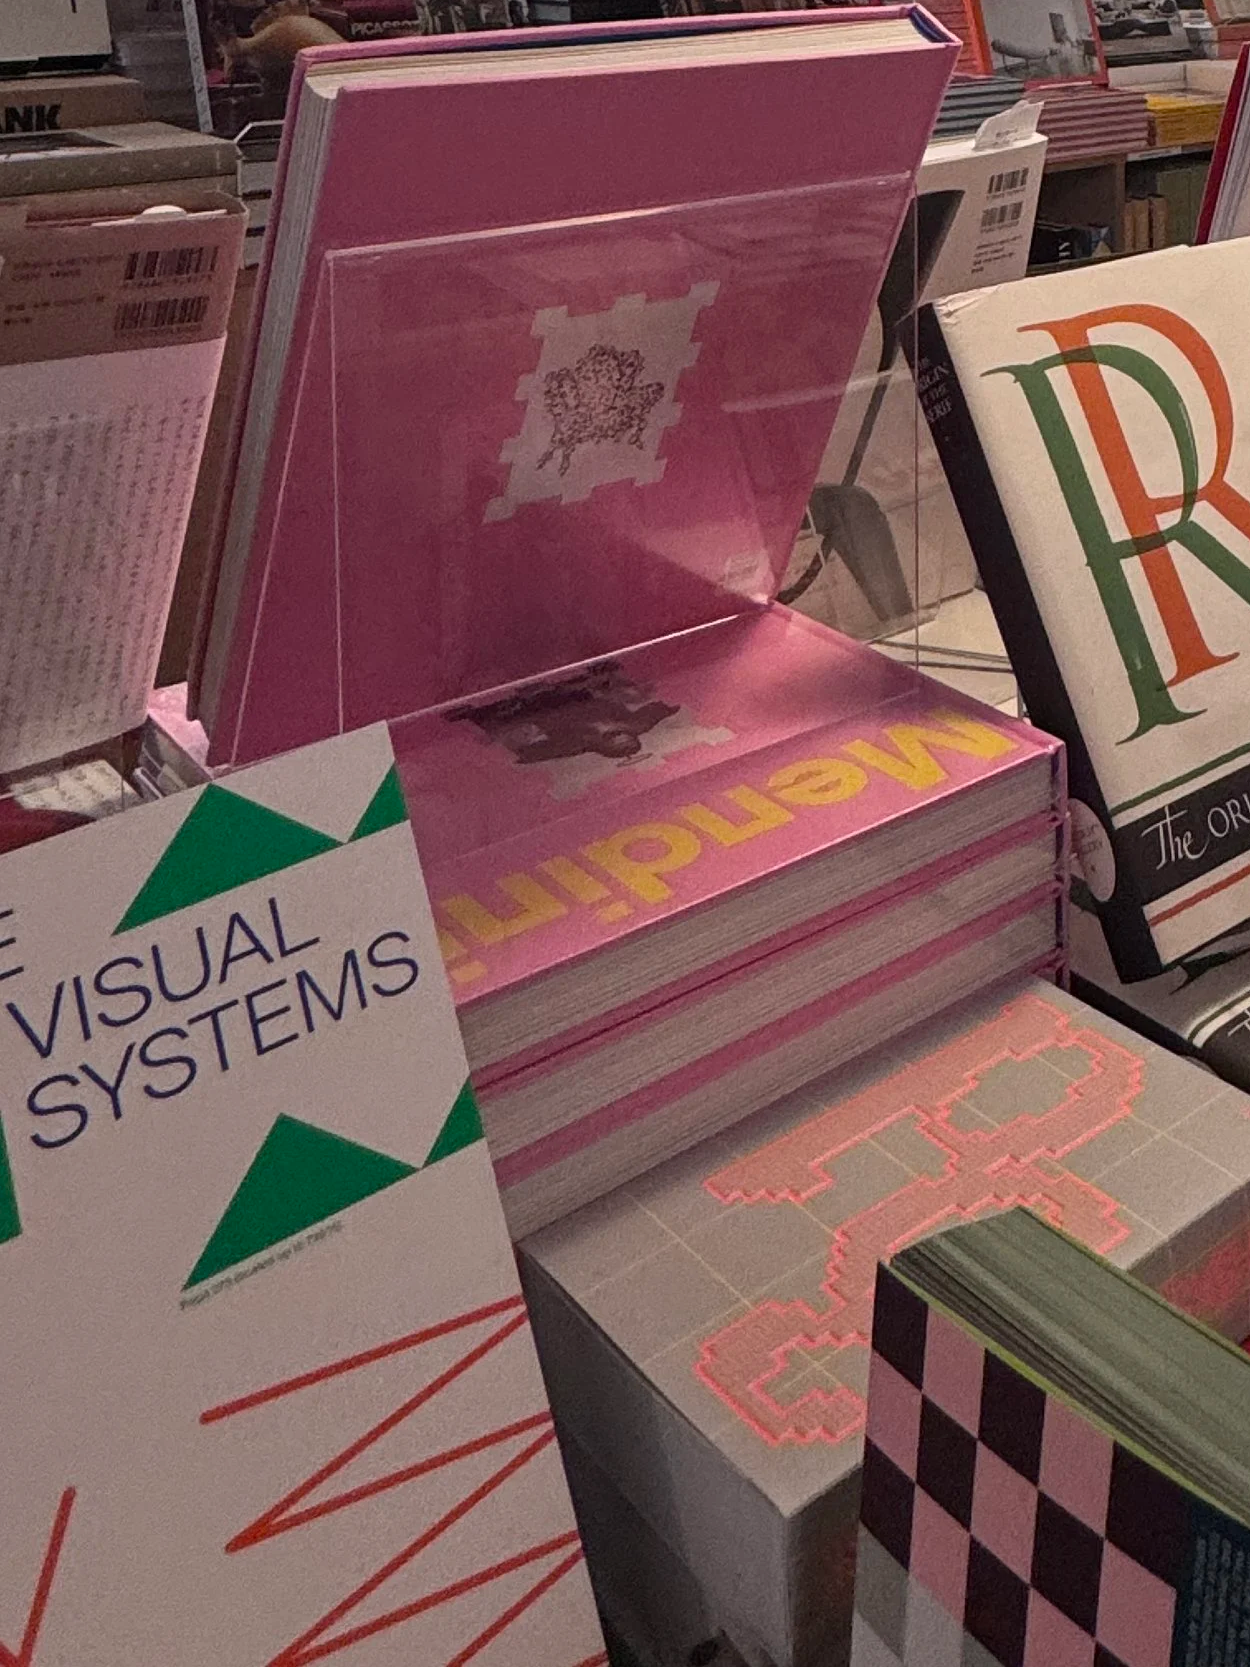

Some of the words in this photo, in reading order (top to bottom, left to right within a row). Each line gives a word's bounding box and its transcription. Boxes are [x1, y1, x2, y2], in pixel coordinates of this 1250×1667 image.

[1141, 803, 1210, 871] The
[6, 896, 320, 1060] VISUAL
[27, 931, 420, 1150] SYSTEMS
